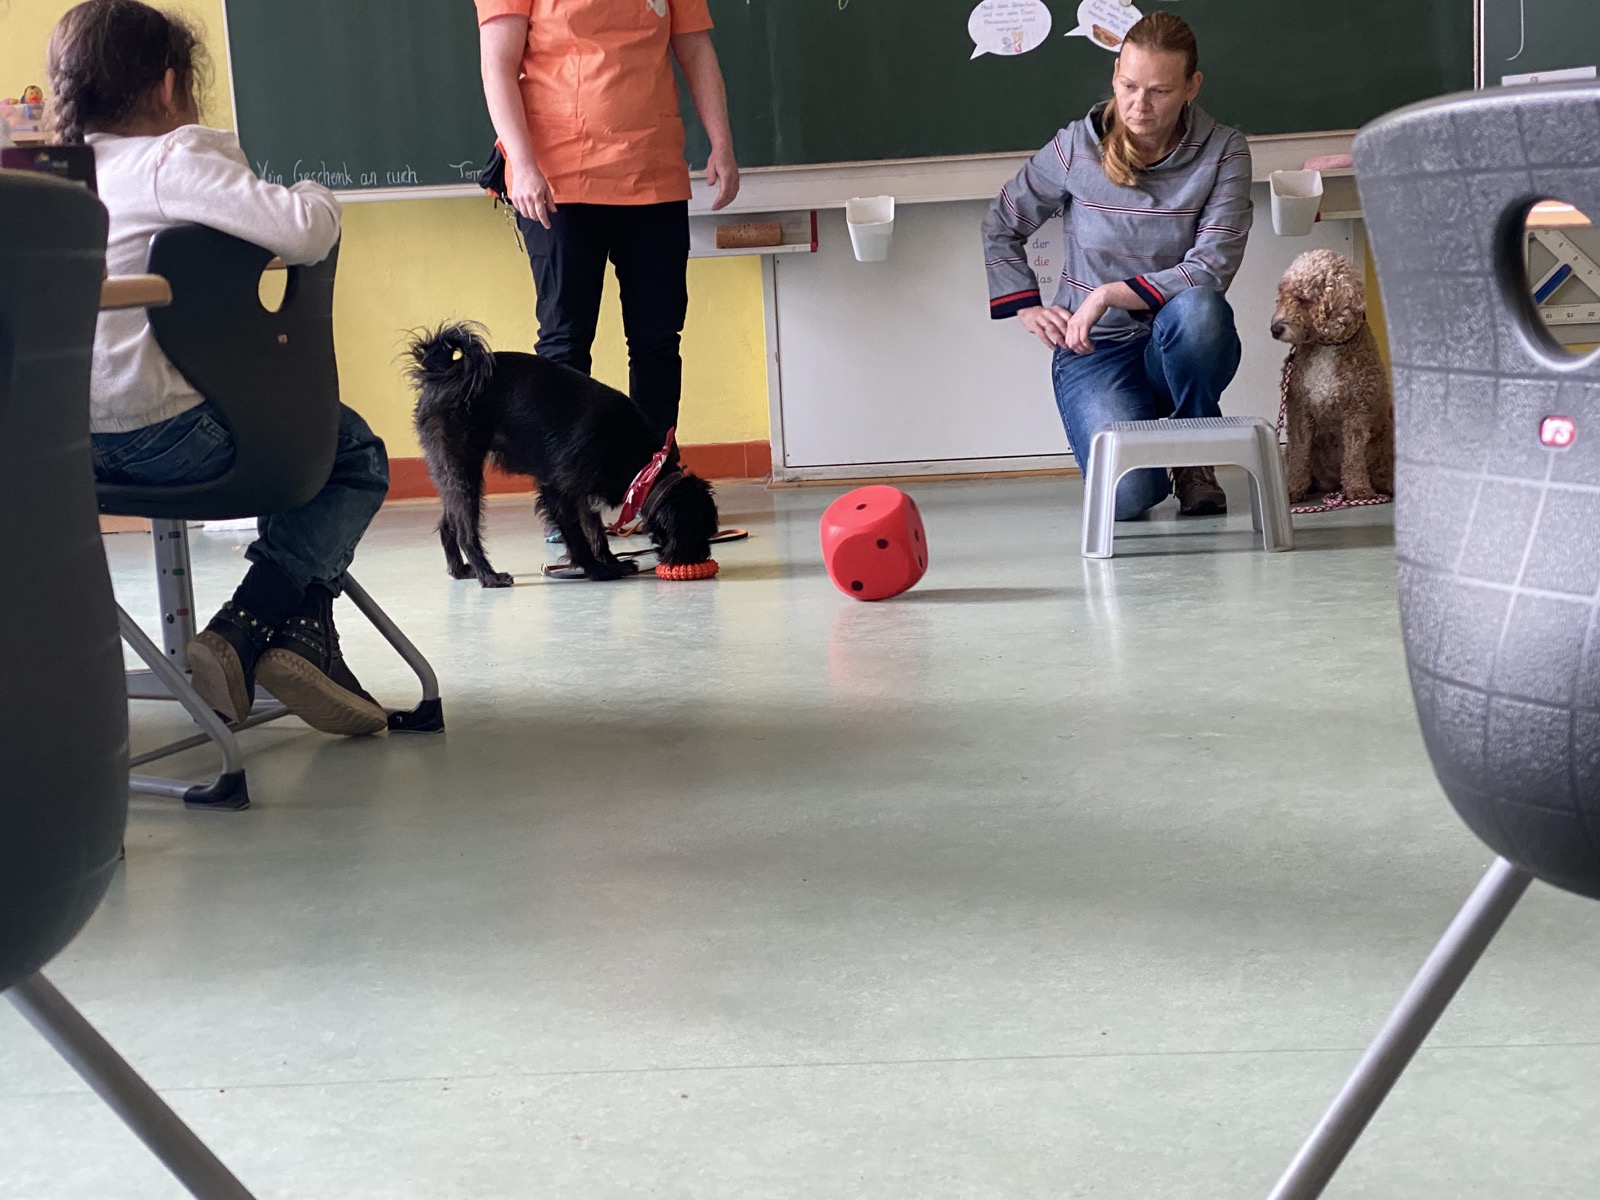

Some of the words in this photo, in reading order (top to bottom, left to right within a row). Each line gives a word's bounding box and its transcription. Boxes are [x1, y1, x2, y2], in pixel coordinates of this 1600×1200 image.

[294, 159, 354, 186] Geschenk
[360, 171, 378, 187] an
[1032, 238, 1050, 249] der
[1033, 254, 1050, 267] die
